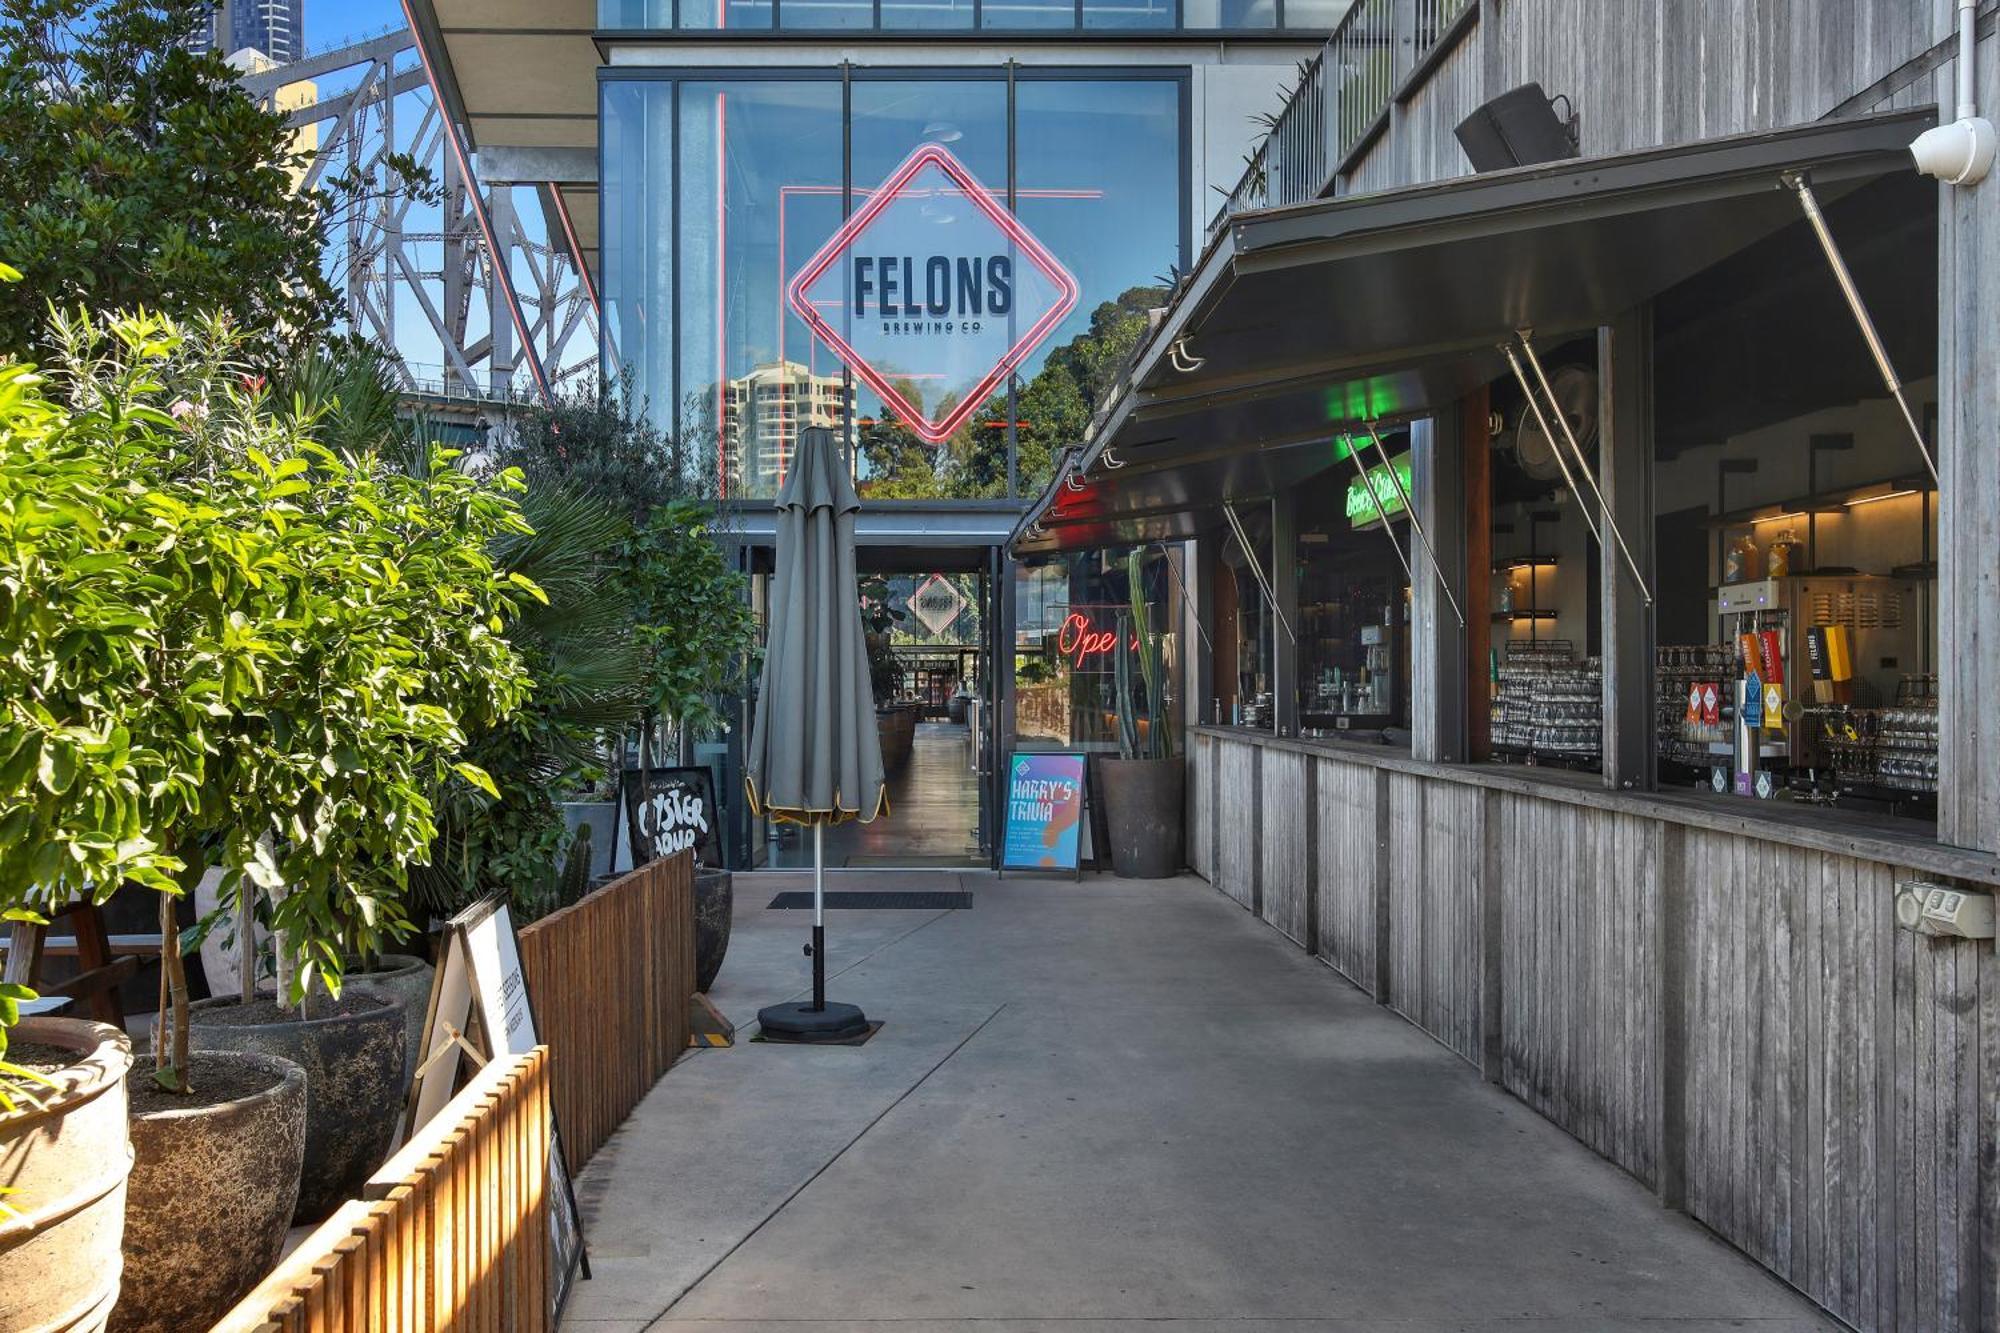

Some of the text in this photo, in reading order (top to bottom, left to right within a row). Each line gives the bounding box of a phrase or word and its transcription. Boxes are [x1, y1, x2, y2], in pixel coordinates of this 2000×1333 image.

[854, 256, 1011, 317] FELONS
[883, 321, 954, 333] BREWING
[1012, 780, 1073, 801] HARRY'S
[1010, 801, 1054, 822] TRIVIA
